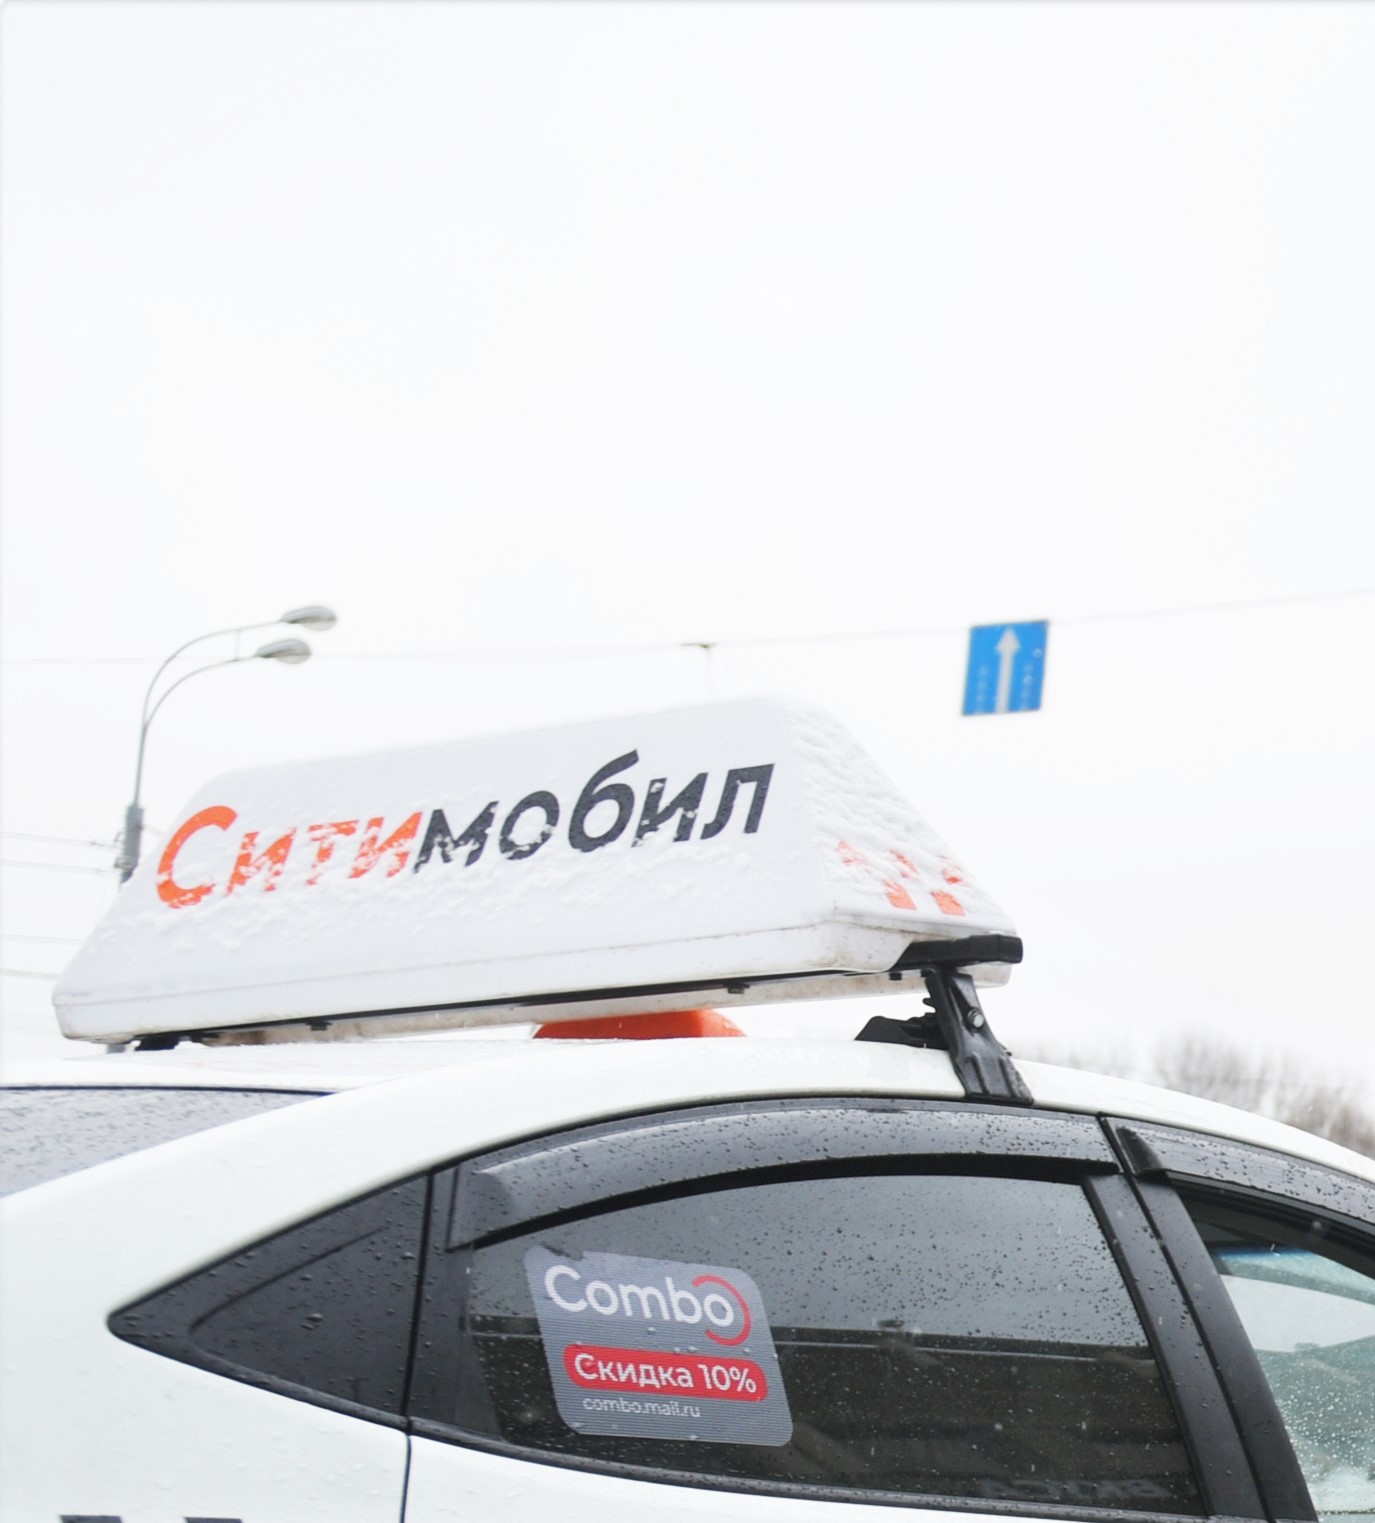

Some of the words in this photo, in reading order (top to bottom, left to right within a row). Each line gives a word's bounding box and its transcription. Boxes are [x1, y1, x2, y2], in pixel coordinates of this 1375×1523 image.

[156, 748, 776, 909] Ситимобил
[544, 1264, 735, 1328] Combo
[573, 1352, 694, 1389] Скидка
[698, 1363, 758, 1394] 10%
[583, 1396, 701, 1418] combo.mail.ru
